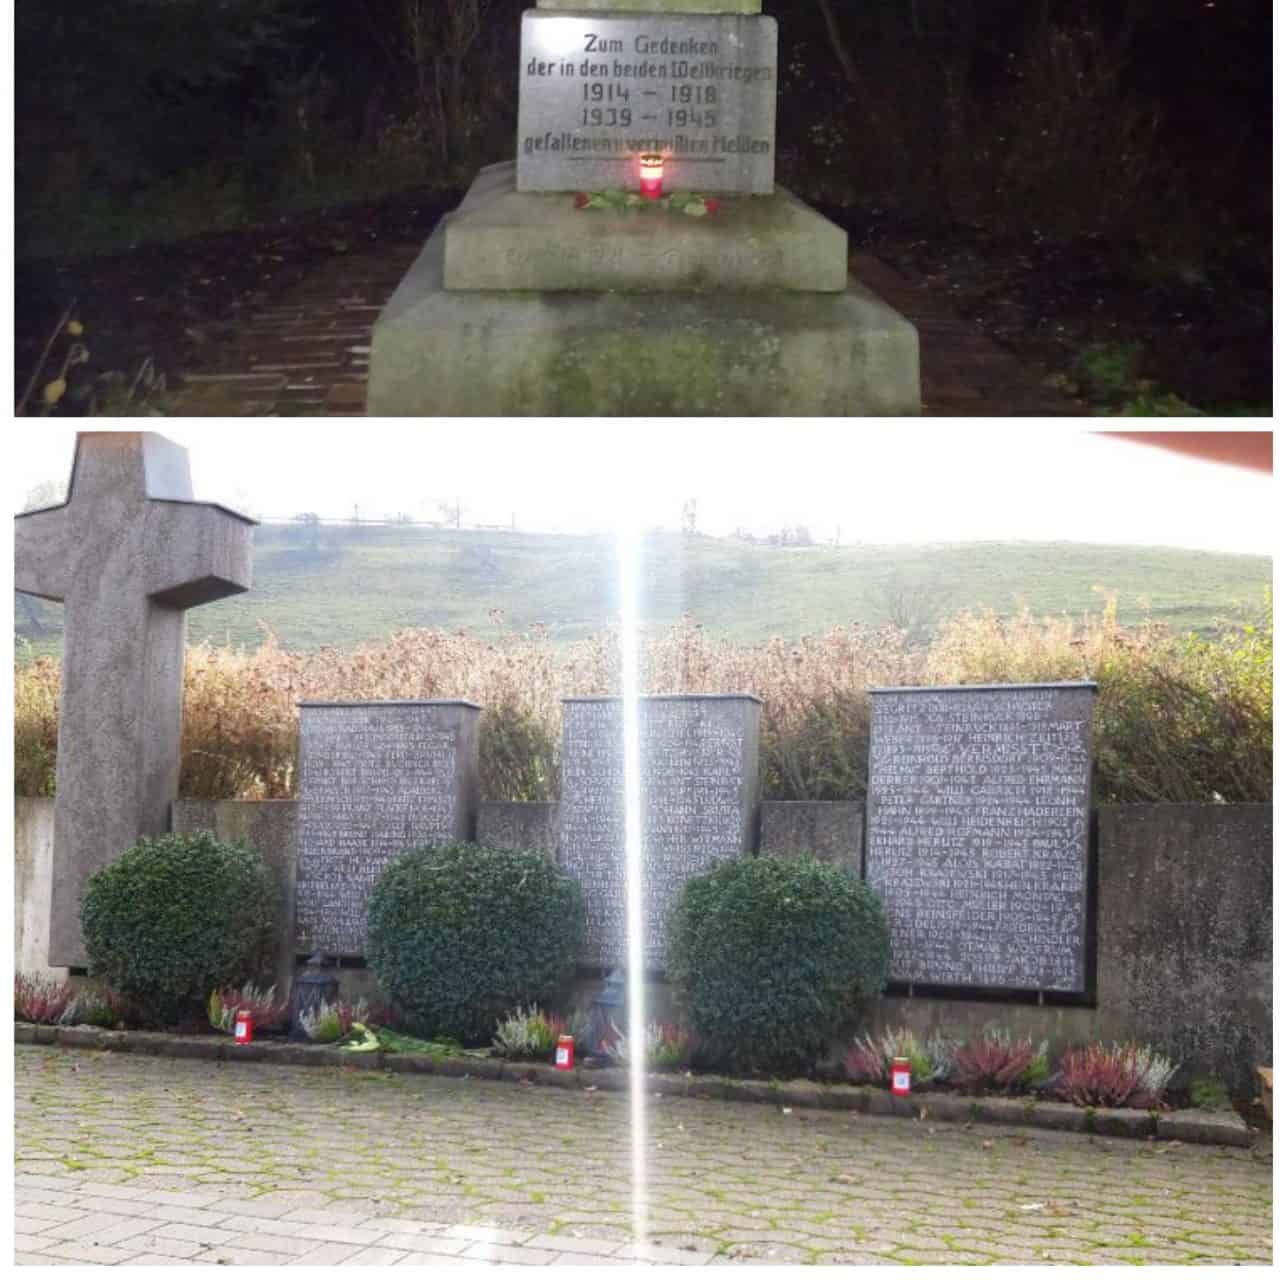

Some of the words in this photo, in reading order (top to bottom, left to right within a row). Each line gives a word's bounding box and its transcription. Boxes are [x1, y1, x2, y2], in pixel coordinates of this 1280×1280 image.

[584, 34, 623, 53] Zum
[634, 35, 718, 54] Gedenken
[528, 59, 557, 76] der
[560, 60, 574, 76] in
[580, 59, 608, 77] den
[613, 61, 667, 78] beiden
[582, 84, 629, 102] 1914
[671, 86, 717, 104] 1918
[582, 109, 632, 127] 1939
[668, 109, 717, 128] 1945
